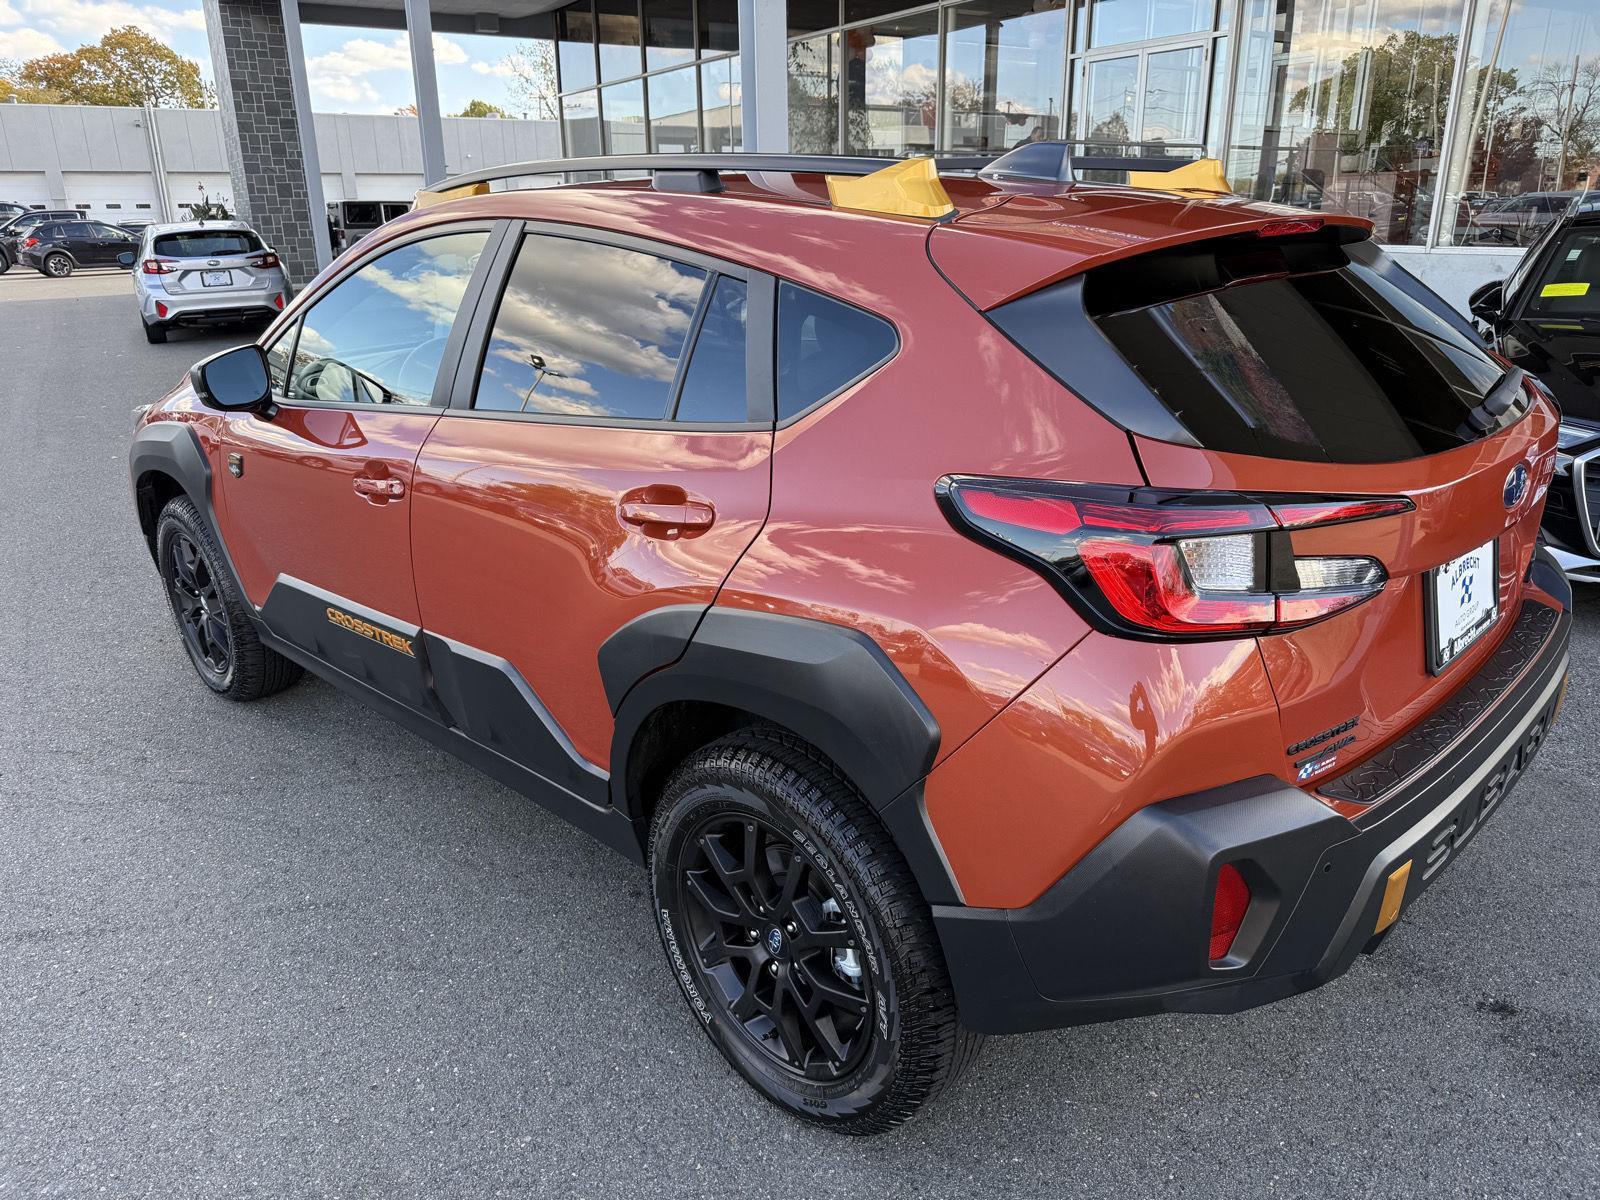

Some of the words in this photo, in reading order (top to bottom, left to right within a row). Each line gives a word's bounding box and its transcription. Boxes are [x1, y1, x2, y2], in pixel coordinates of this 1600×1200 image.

[1450, 557, 1480, 591] ALBRECHT
[325, 607, 415, 657] CROSSTREK
[1287, 715, 1360, 756] CROSSTREK
[792, 829, 879, 976] GEOLANDAR
[661, 908, 713, 1024] YOKOHAMA
